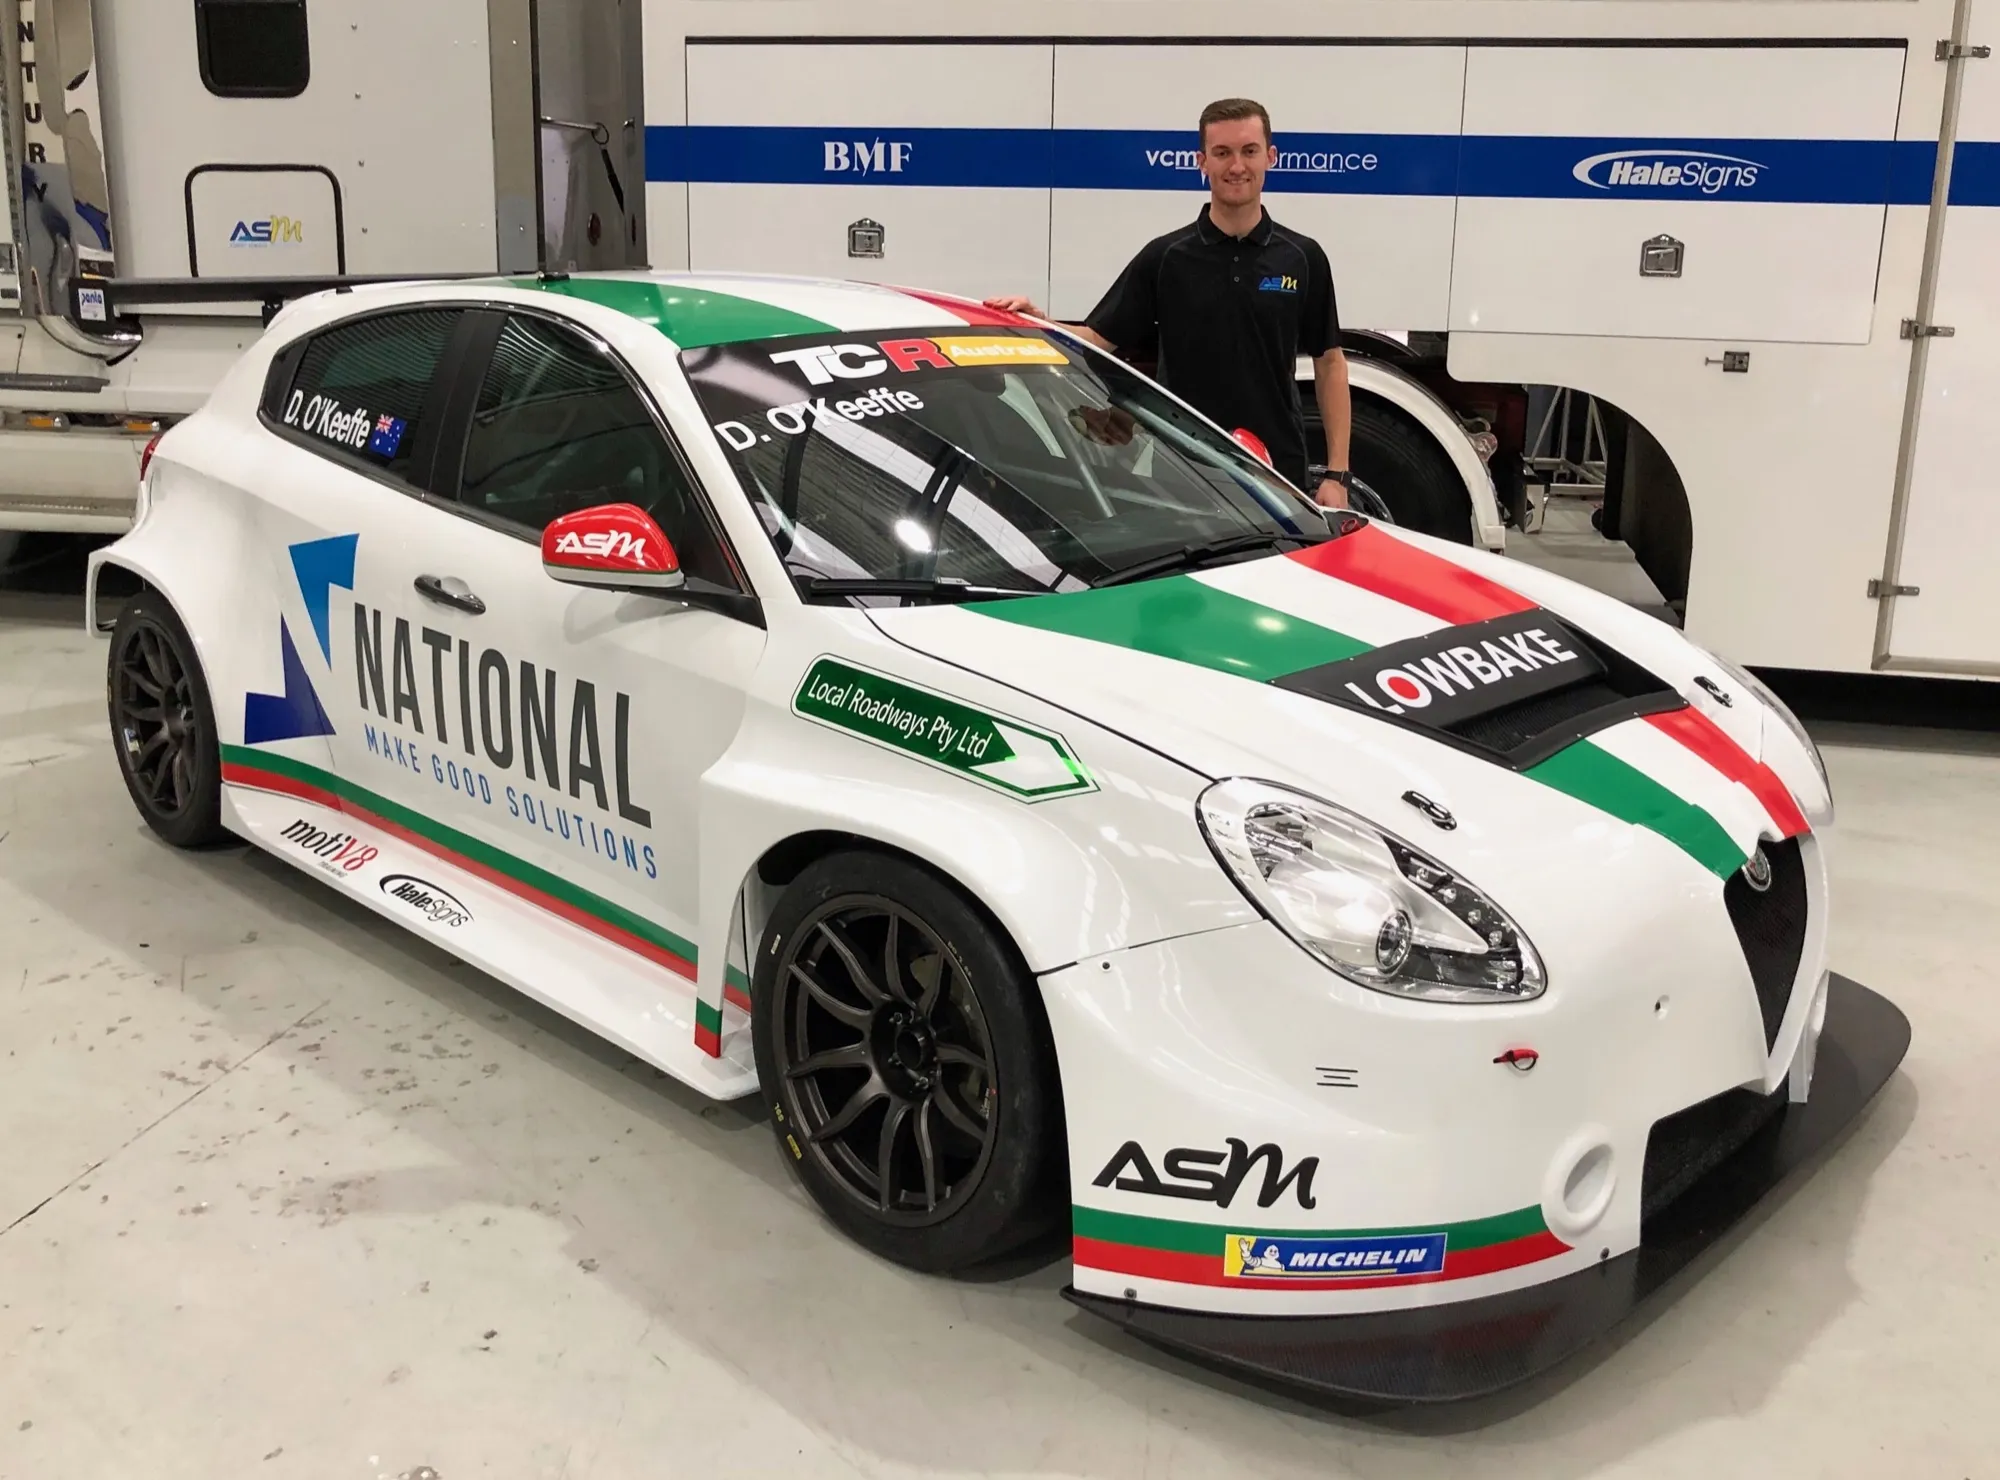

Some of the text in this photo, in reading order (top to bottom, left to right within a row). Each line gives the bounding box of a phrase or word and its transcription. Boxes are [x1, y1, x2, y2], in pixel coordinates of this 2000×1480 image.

[17, 0, 47, 202] NTURY
[823, 136, 913, 177] BMF
[1607, 160, 1759, 194] HaleSigns
[229, 215, 303, 244] ASM
[1258, 275, 1298, 291] ASM
[769, 338, 1058, 386] TCR Australia
[284, 389, 371, 449] D. O'Keeffe
[714, 387, 925, 452] D. O'Keeffe
[555, 529, 647, 567] ASM
[1344, 628, 1579, 715] LOWBAKE
[354, 602, 652, 830] NATIONAL
[808, 674, 993, 759] Local Roadways Pty Ltd
[364, 722, 658, 879] MAKE GOOD SOLUTIONS
[280, 818, 379, 872] motiV8
[390, 881, 470, 929] HaleSigns
[1091, 1137, 1320, 1210] ASM
[1289, 1247, 1428, 1269] MICHELIN
